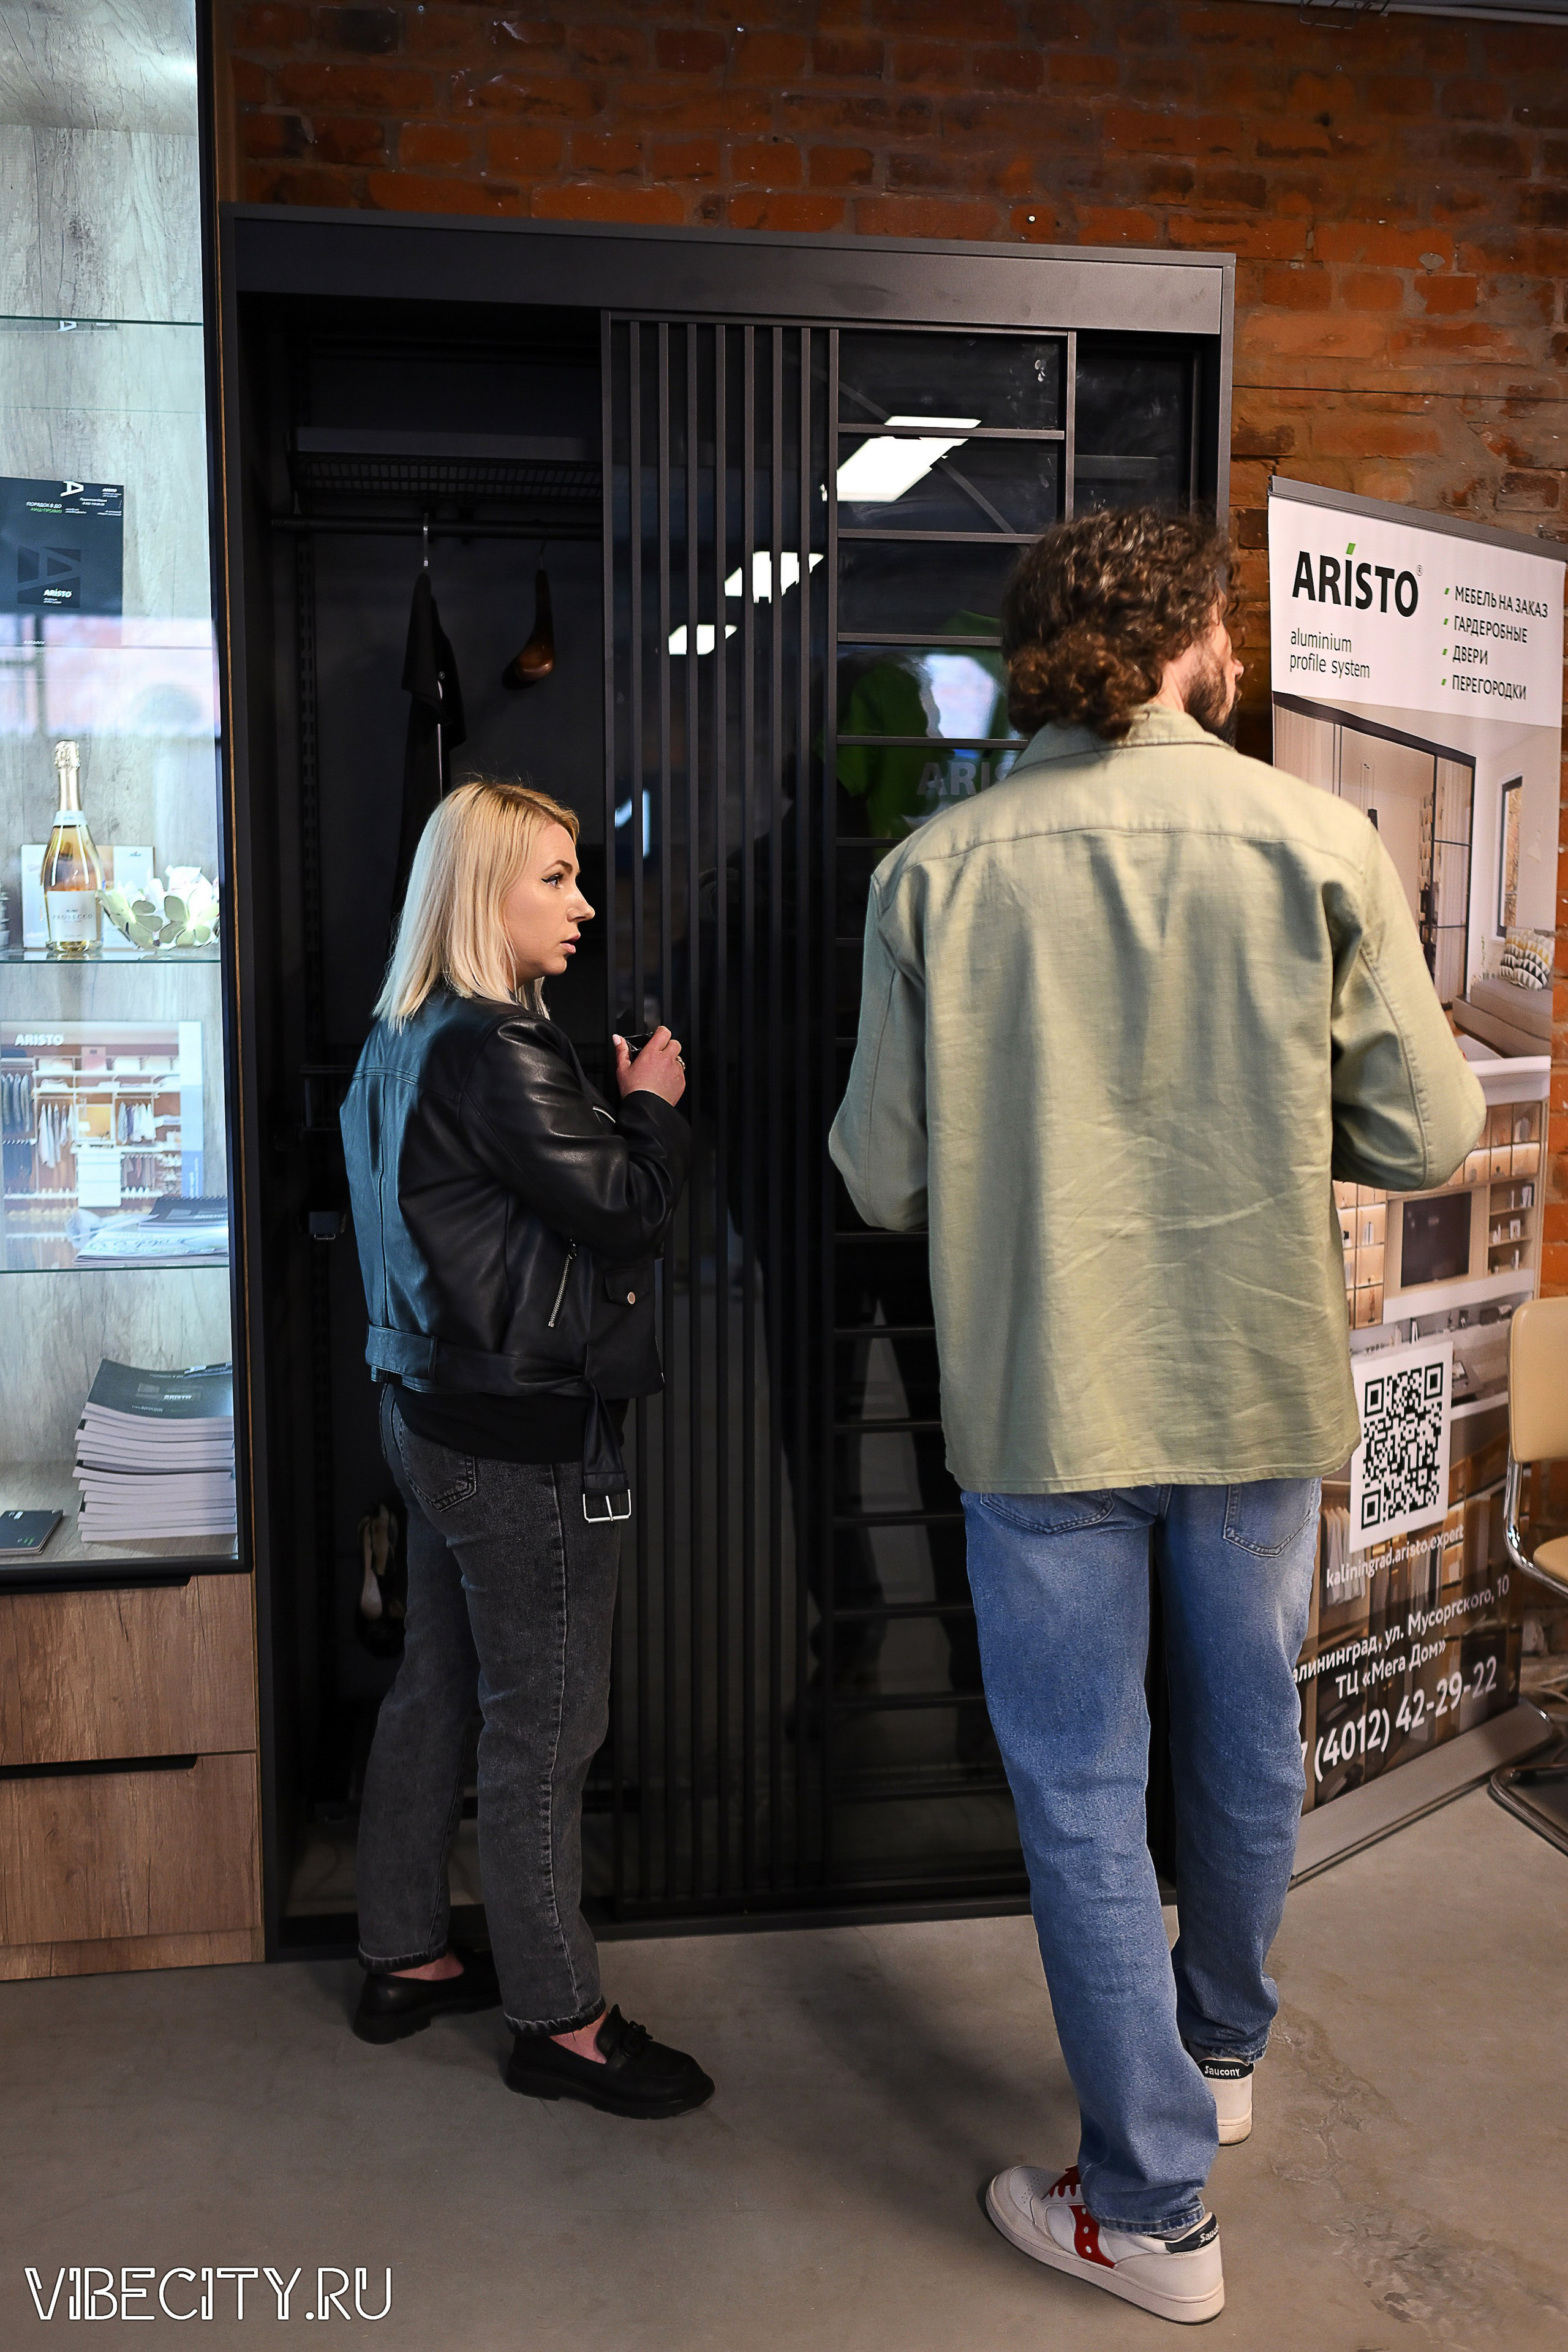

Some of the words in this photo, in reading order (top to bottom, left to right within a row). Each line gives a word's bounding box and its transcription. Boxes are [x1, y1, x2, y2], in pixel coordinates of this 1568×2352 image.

[1455, 586, 1497, 608] МЕБЕЛЬ
[1499, 594, 1513, 612] НА
[1515, 598, 1548, 619] ЗАКАЗ
[1291, 627, 1352, 653] aluminium
[1454, 615, 1528, 644] ГАРДЕРОБНЫЕ
[1290, 653, 1326, 673] profile
[1332, 660, 1370, 679] system
[1452, 645, 1488, 665] ДВЕРИ
[1452, 674, 1527, 701] ПЕРЕГОРОДКИ
[1327, 1524, 1464, 1589] kaliningrad.aristo.expert
[1292, 1635, 1382, 1684] алининград,
[1385, 1626, 1404, 1649] ул.
[1408, 1589, 1494, 1637] Мусоргского,
[1498, 1574, 1509, 1597] 10
[1335, 1670, 1359, 1700] ТЦ
[1362, 1656, 1406, 1687] «Мега
[1409, 1638, 1446, 1672] Дом»
[1314, 1708, 1390, 1782] (4012)
[1396, 1656, 1497, 1732] 42-29-22
[1204, 2065, 1240, 2077] Saucony
